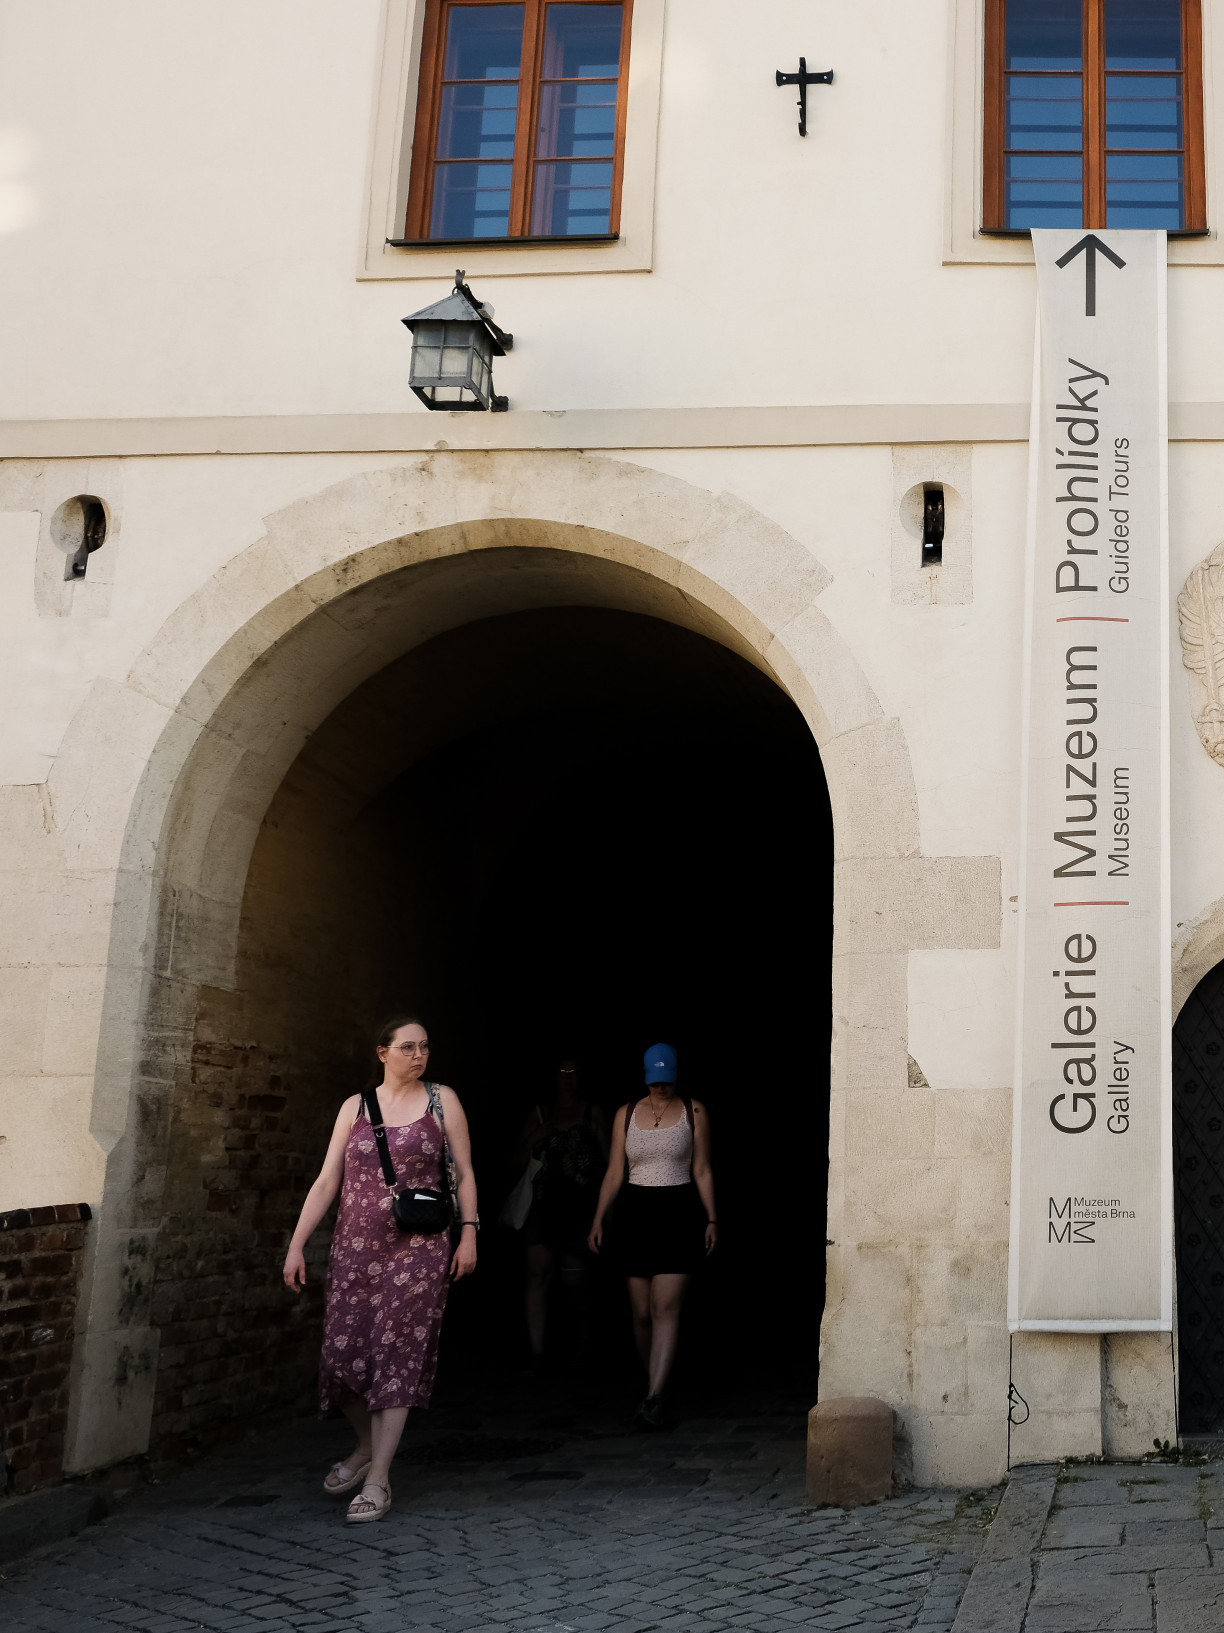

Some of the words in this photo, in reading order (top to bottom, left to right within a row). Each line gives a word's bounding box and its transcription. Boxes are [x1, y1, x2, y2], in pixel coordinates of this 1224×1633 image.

[1055, 357, 1110, 593] Prohlídky
[1108, 437, 1130, 502] Tours
[1108, 508, 1130, 594] Guided
[1052, 645, 1098, 879] Muzeum
[1107, 767, 1130, 877] Museum
[1048, 932, 1098, 1135] Galerie
[1106, 1040, 1135, 1135] Gallery
[1073, 1208, 1108, 1219] města
[1110, 1209, 1136, 1219] Brna
[1074, 1197, 1121, 1207] Muzeum
